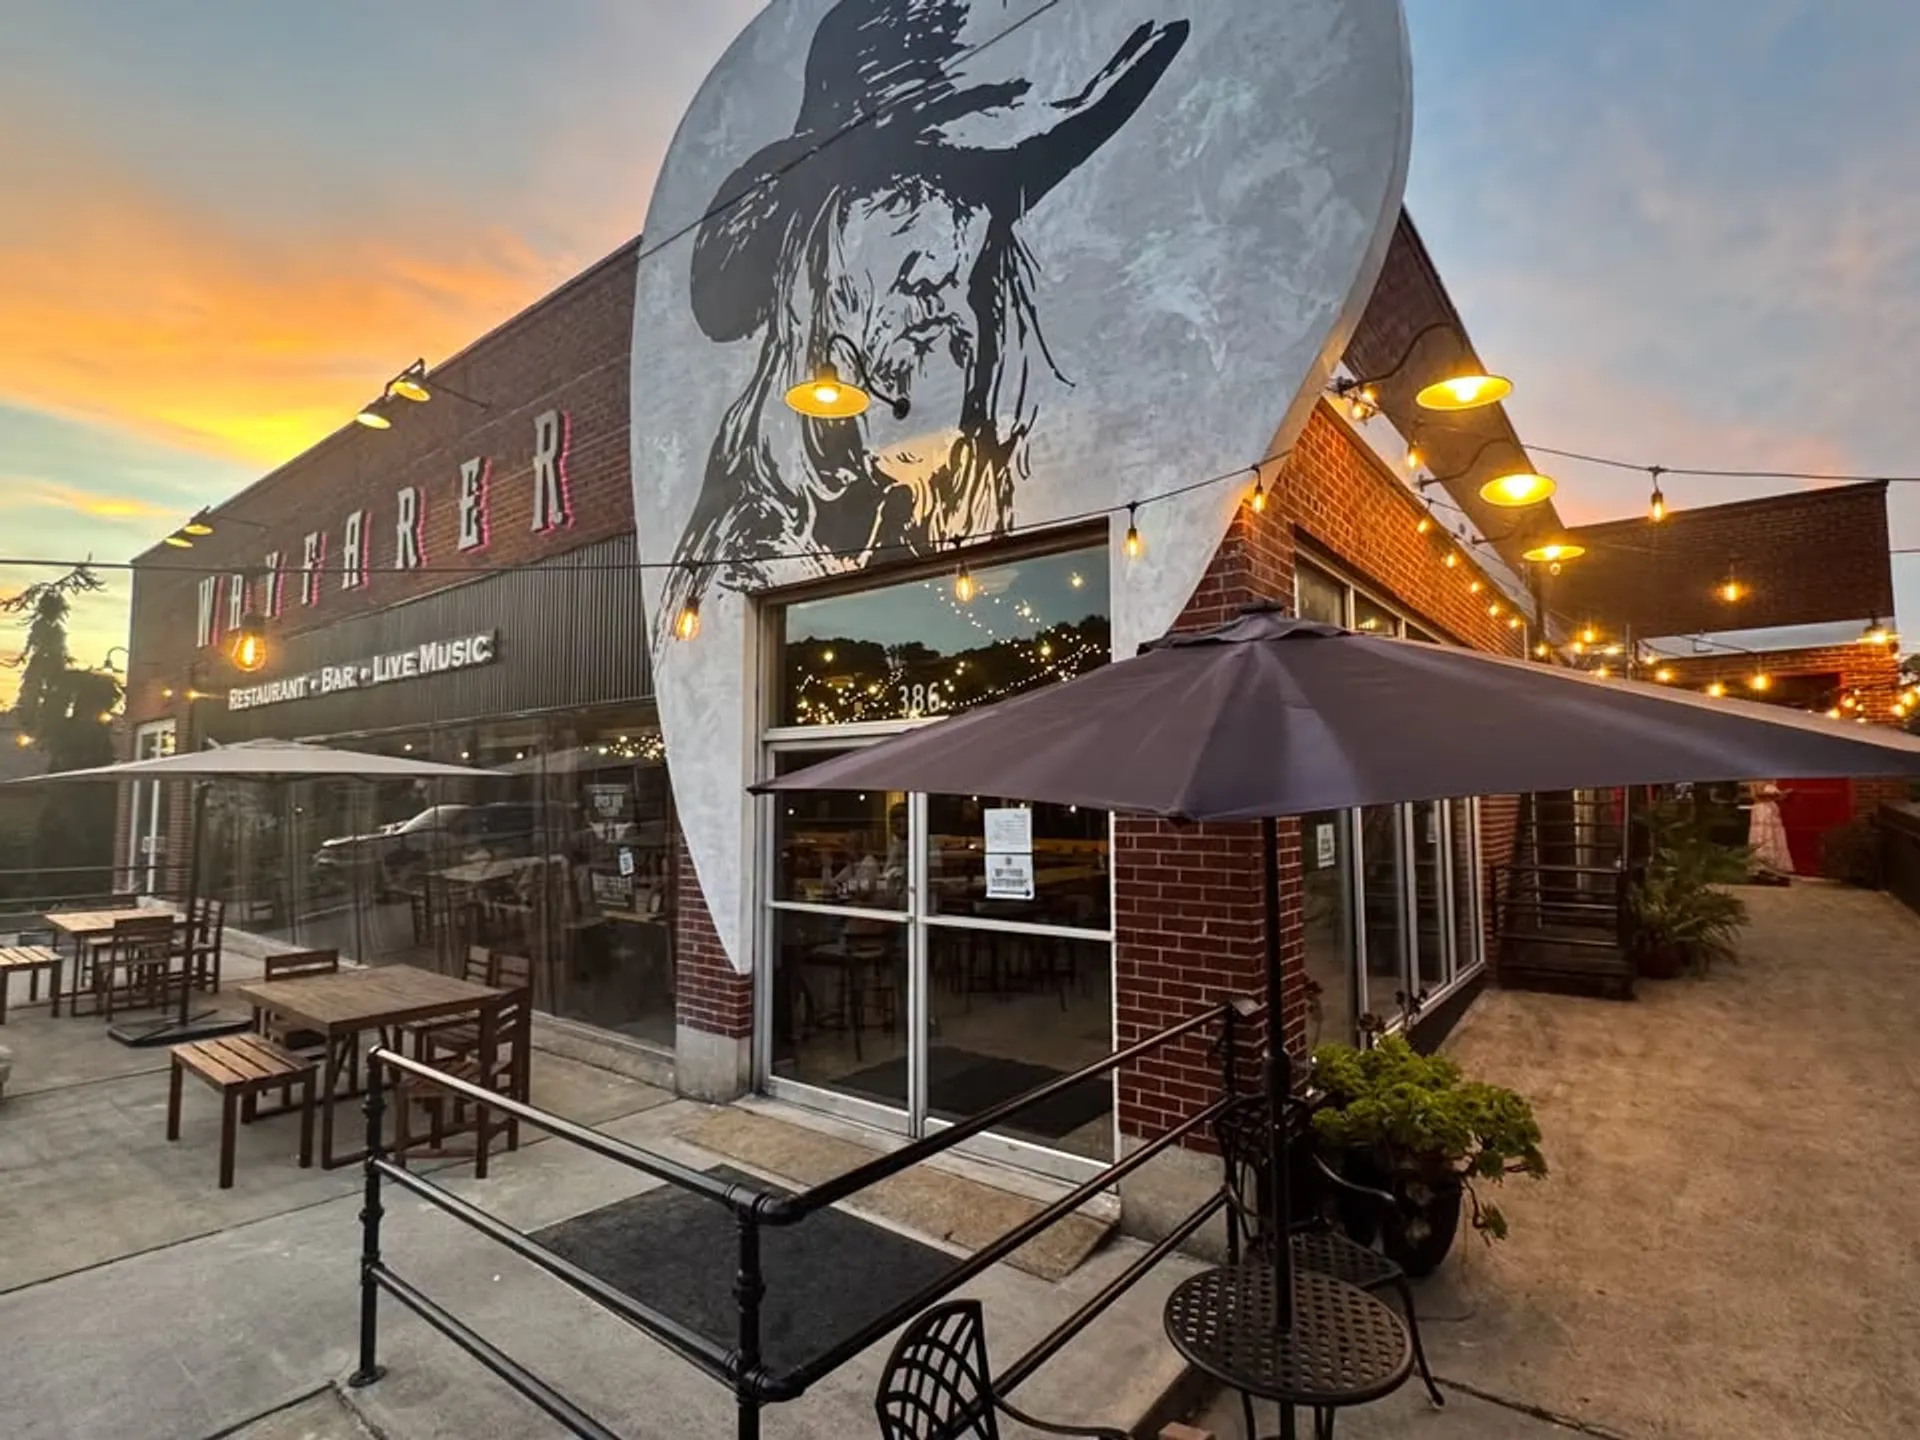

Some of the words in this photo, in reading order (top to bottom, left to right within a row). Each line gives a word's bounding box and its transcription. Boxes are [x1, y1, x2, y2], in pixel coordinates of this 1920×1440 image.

[197, 409, 572, 649] WAYFARER
[228, 675, 307, 711] RESTAURANT
[321, 664, 359, 693] BAR
[373, 652, 419, 682] LIVE
[419, 634, 494, 674] MUSIC
[898, 681, 941, 715] 386
